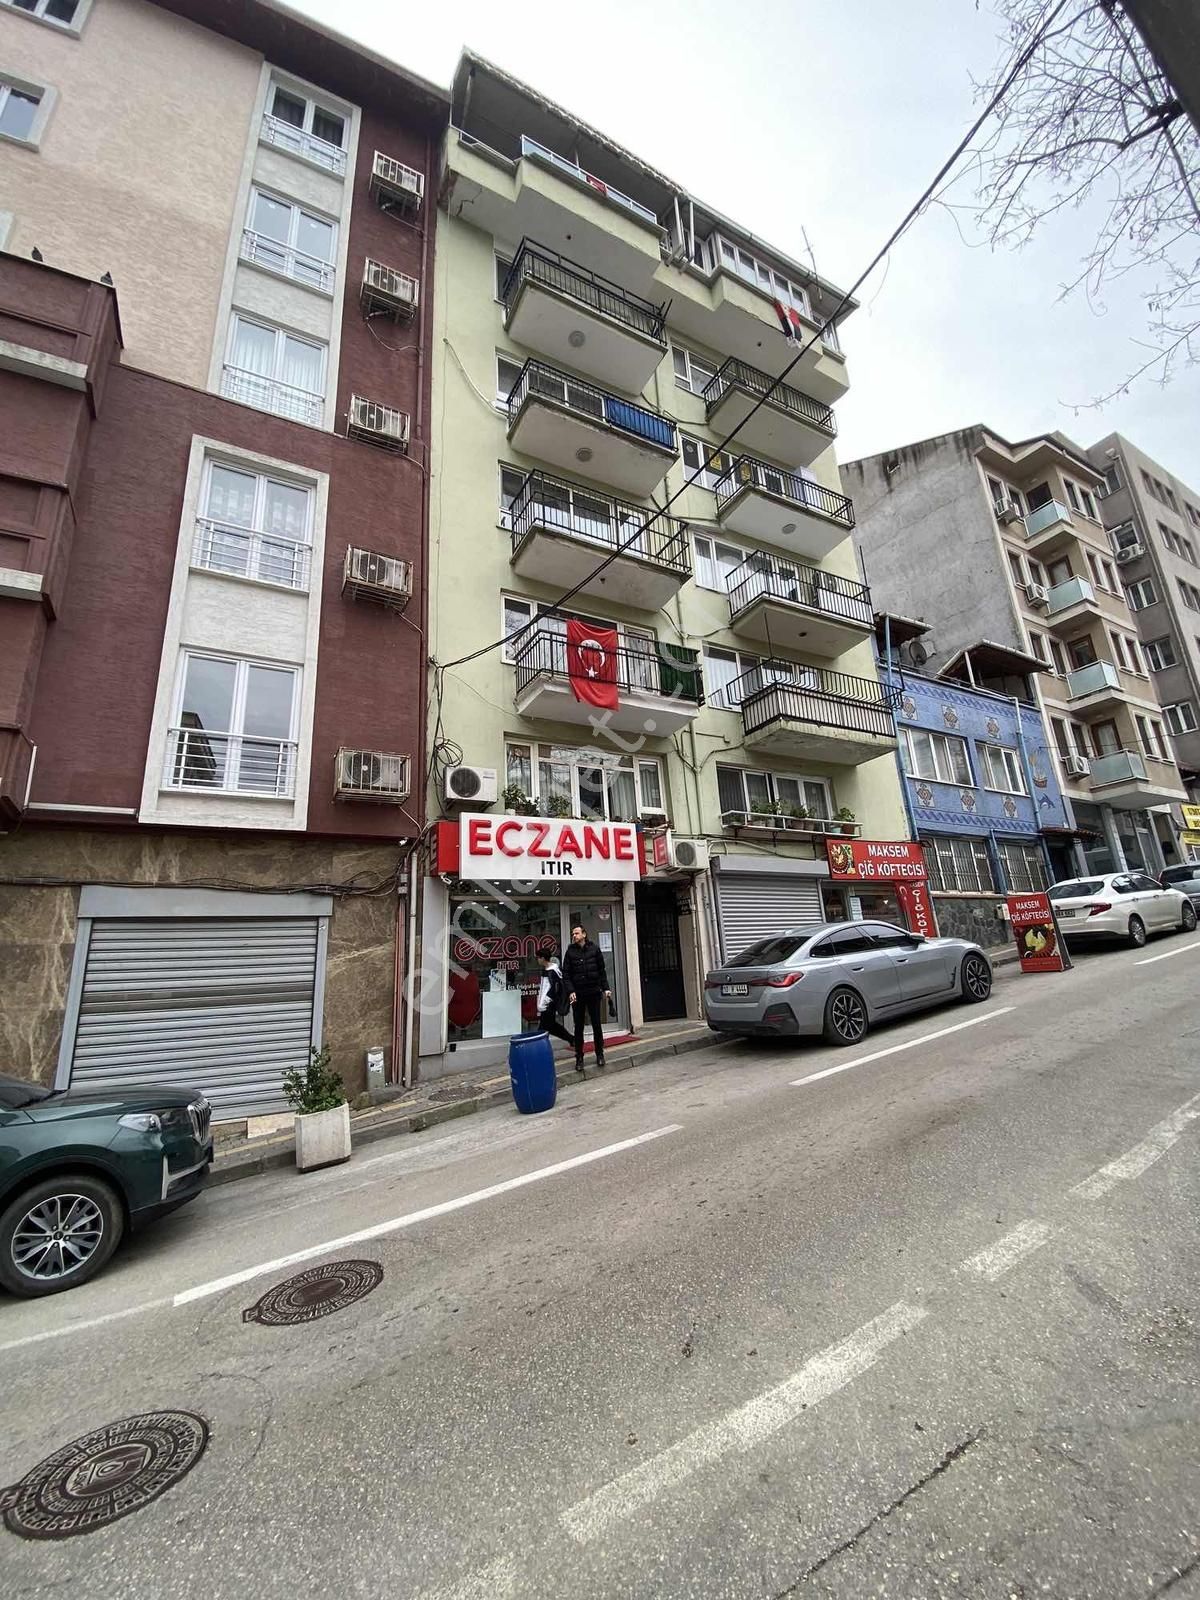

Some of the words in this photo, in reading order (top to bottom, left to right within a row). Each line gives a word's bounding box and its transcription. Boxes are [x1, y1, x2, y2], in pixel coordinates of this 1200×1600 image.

[469, 819, 634, 860] ECZANE
[868, 844, 909, 857] MAKSEM
[541, 861, 574, 876] ITIR
[858, 860, 875, 878] ÇİĞ
[877, 860, 925, 876] KÖFTECİSİ
[1015, 900, 1040, 910] MAKSEM
[455, 935, 558, 960] eczane
